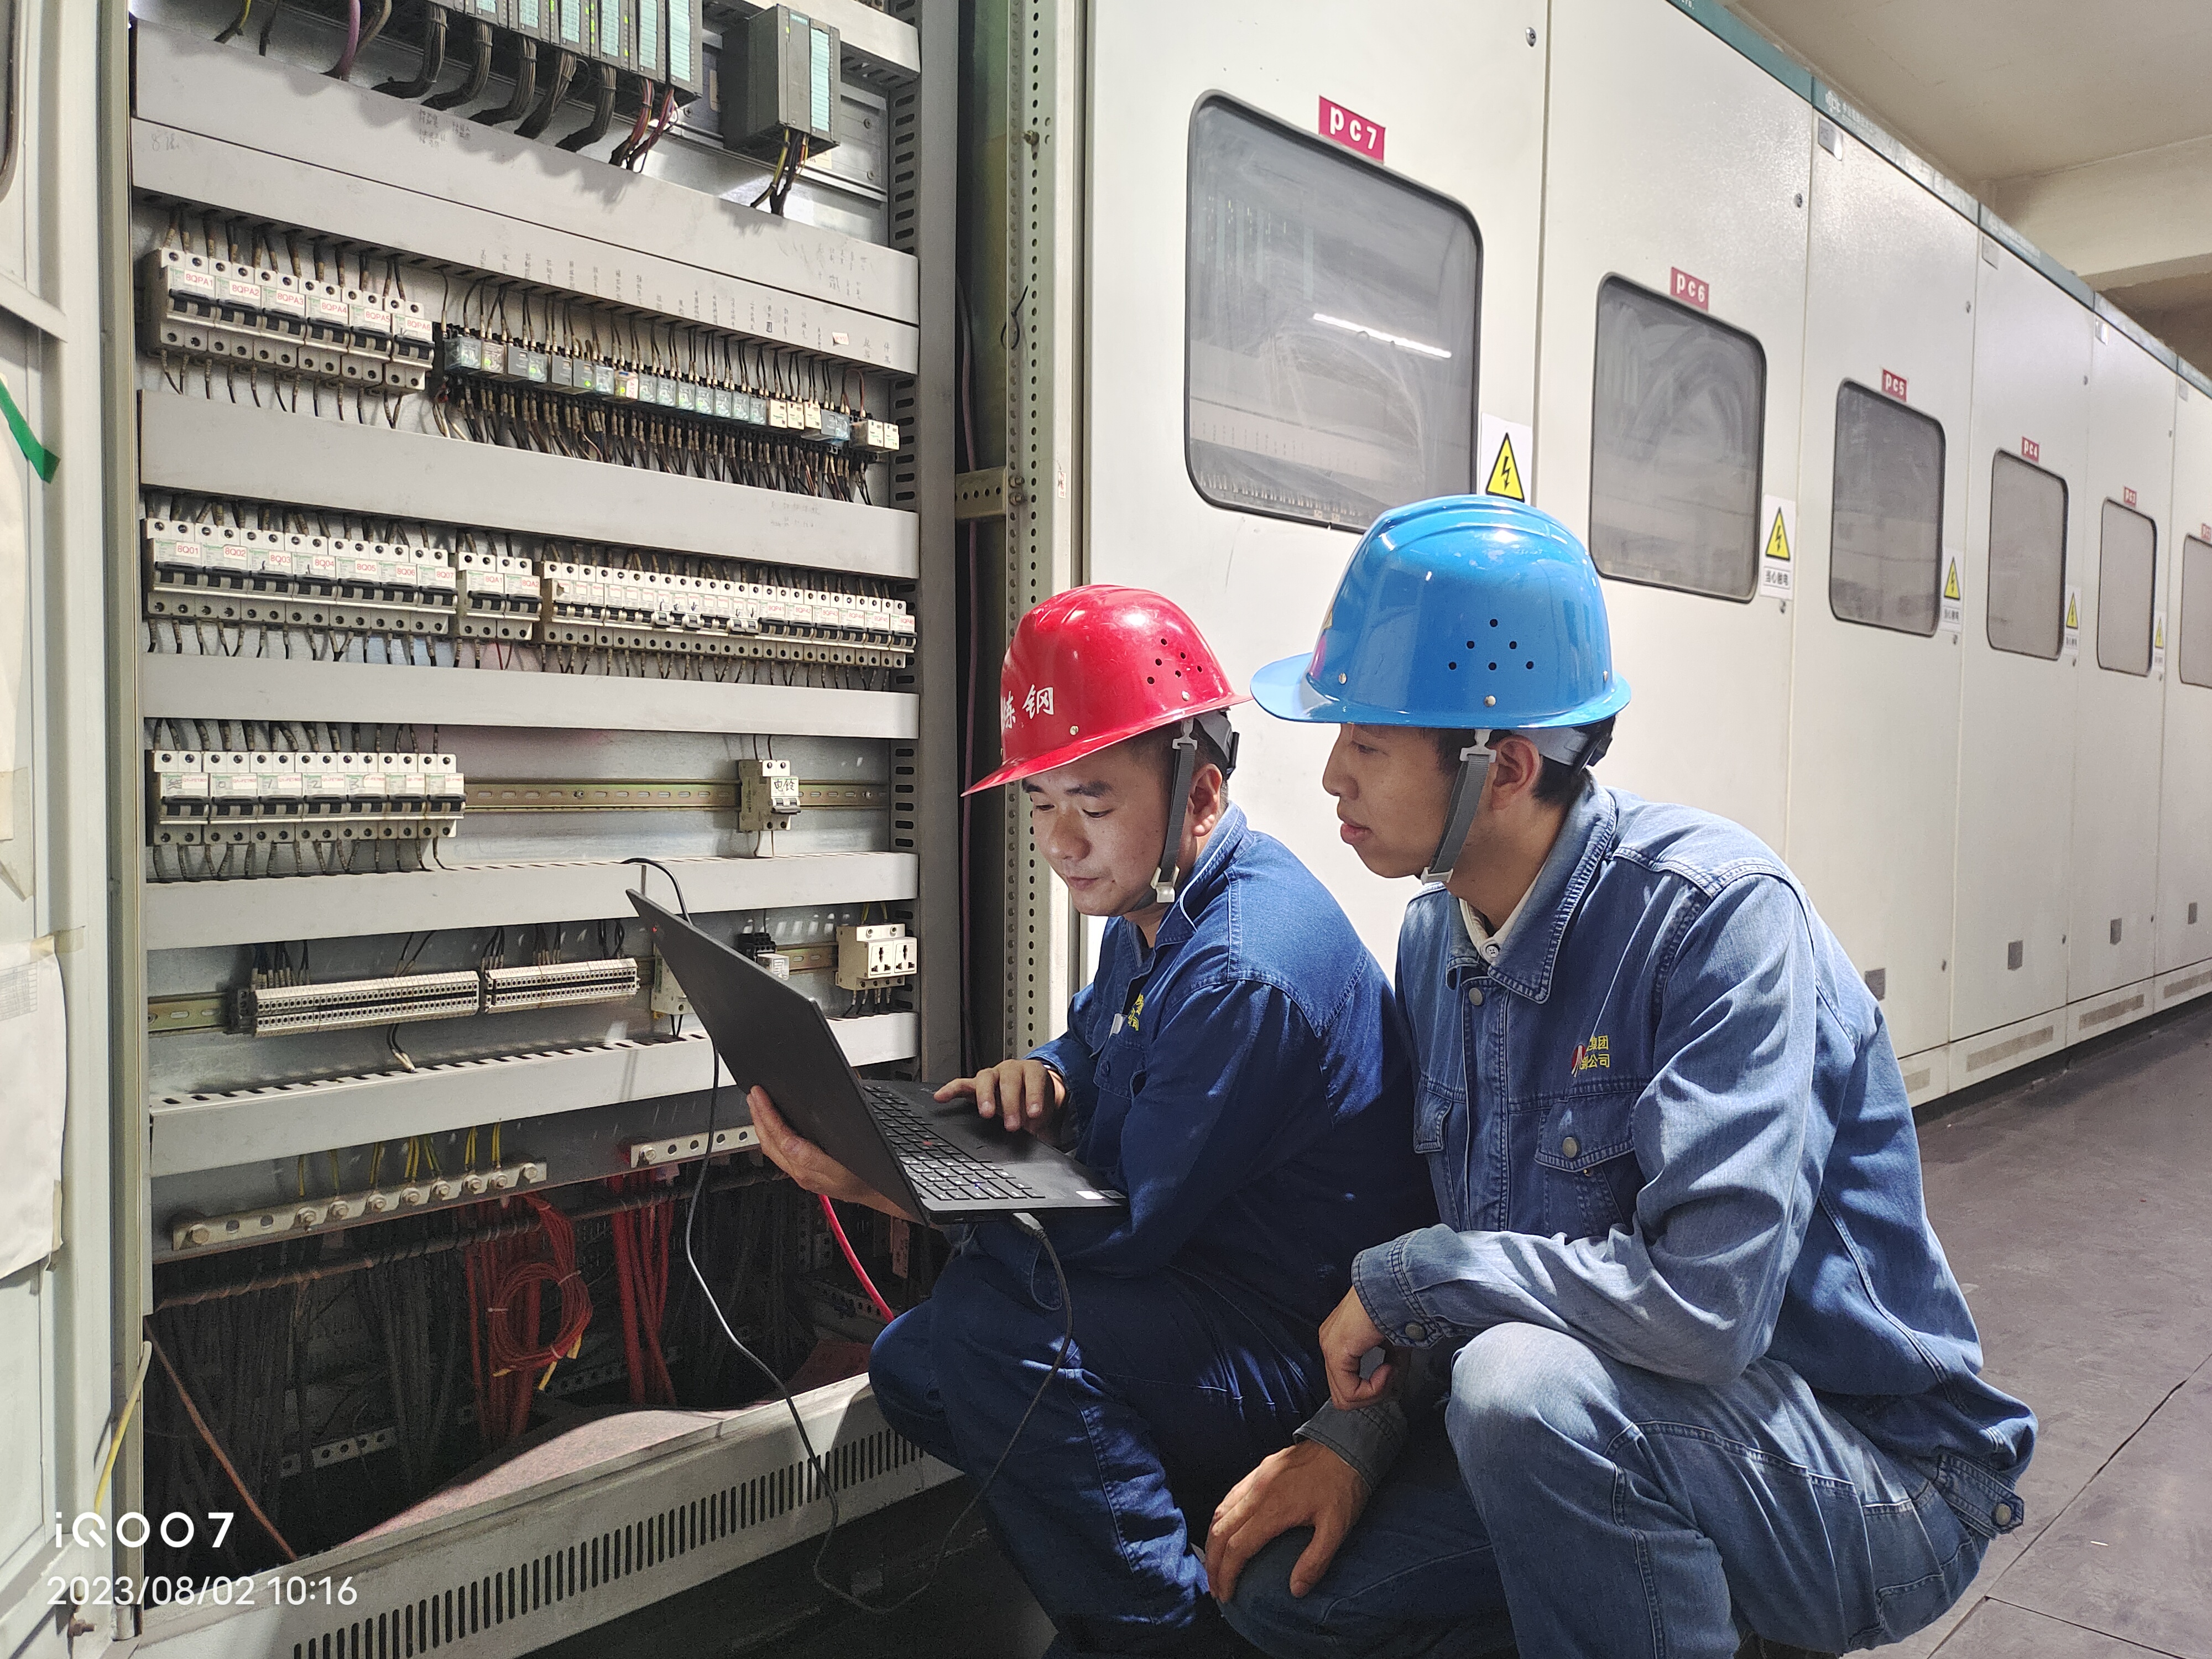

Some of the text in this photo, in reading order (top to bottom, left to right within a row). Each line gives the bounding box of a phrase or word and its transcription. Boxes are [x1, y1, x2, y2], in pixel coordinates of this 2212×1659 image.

[1329, 106, 1378, 149] pc7
[186, 274, 213, 287] 8QPA1
[232, 284, 260, 296] 8QPA2
[1677, 273, 1705, 302] pc6
[277, 293, 304, 305] 8QPA3
[321, 302, 347, 314] 8QPA4
[366, 311, 390, 323] 8QPA5
[408, 320, 431, 331] 8QPA6
[1885, 373, 1905, 396] pc5
[178, 545, 199, 554] 8Q01
[225, 547, 246, 557] 8Q02
[270, 555, 291, 563] 8Q03
[315, 559, 334, 567] 8Q04
[357, 563, 376, 572] 8Q05
[397, 567, 415, 576] 8Q06
[436, 571, 454, 579] 8Q07
[774, 778, 795, 792] 电铃
